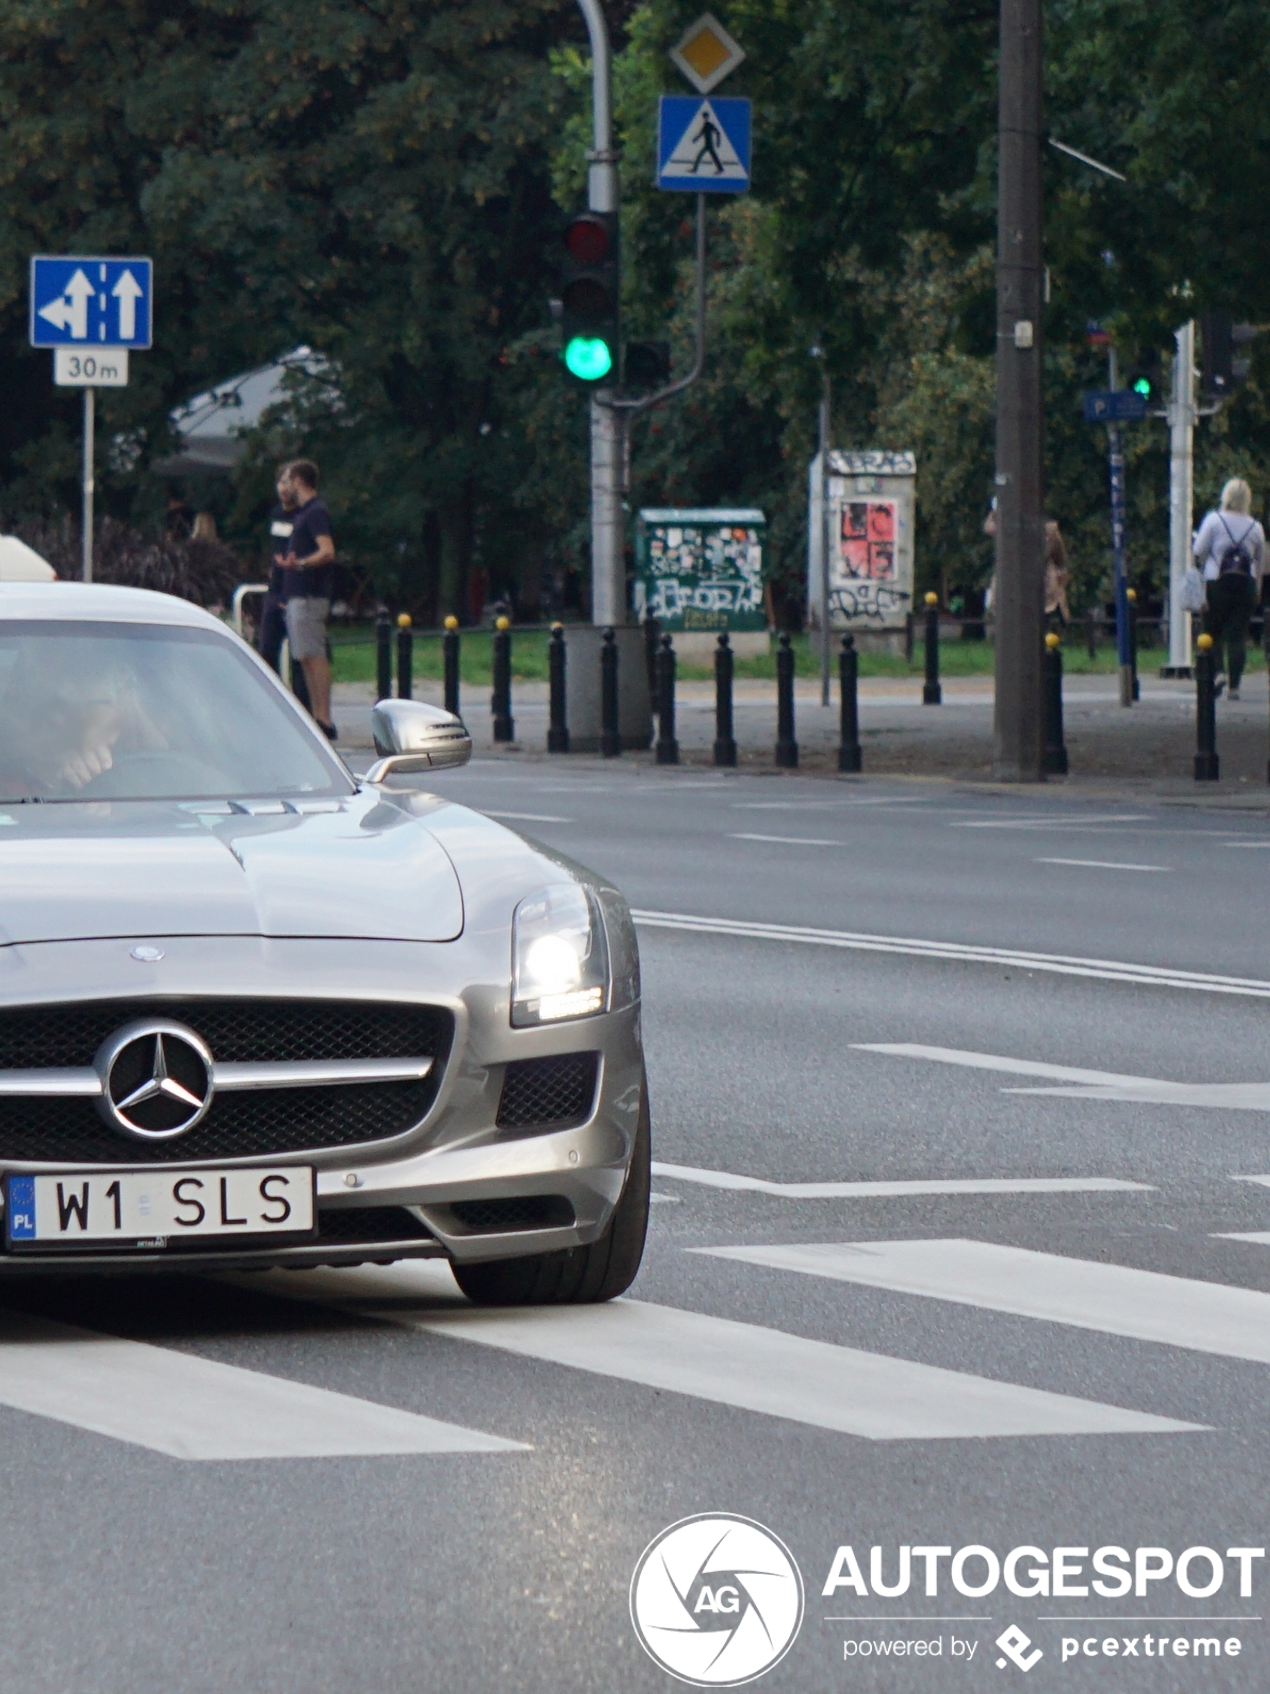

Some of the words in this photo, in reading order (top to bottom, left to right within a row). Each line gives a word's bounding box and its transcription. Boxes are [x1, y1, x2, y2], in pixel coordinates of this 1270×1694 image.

[13, 1214, 33, 1229] PL
[56, 1180, 122, 1232] W1
[173, 1175, 291, 1226] SLS
